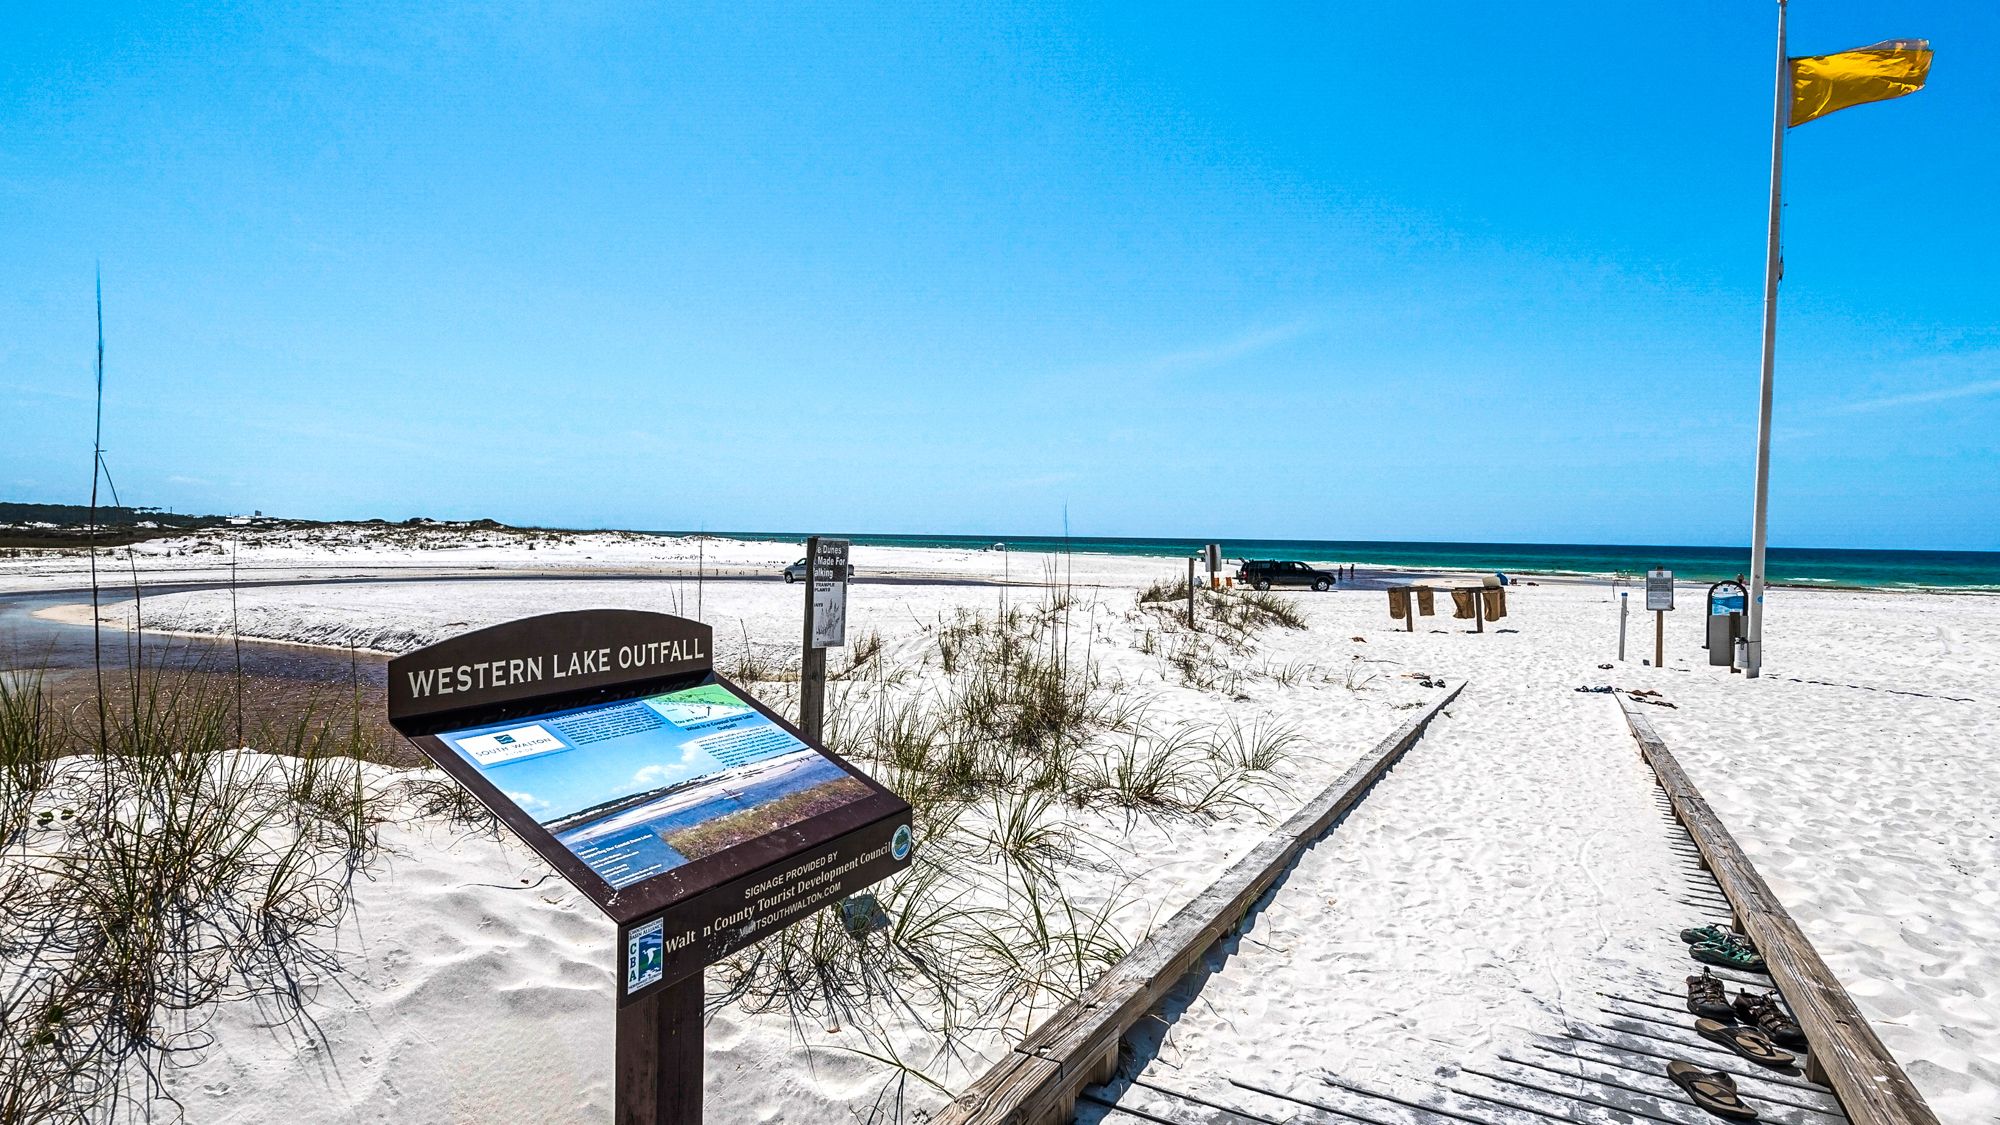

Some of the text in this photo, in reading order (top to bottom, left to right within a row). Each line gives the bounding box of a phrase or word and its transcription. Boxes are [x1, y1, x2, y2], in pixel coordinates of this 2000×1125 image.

[814, 567, 834, 580] alking
[817, 556, 846, 566] Made For
[408, 638, 704, 698] WESTERN LAKE OUTFALL
[476, 738, 552, 756] SOUTH WALTON
[744, 851, 838, 899] SIGNAGE PROVIDED BY
[665, 925, 711, 954] Waltn
[714, 904, 756, 932] County
[757, 885, 796, 912] Tourist
[798, 857, 859, 894] Development
[860, 841, 891, 865] Council
